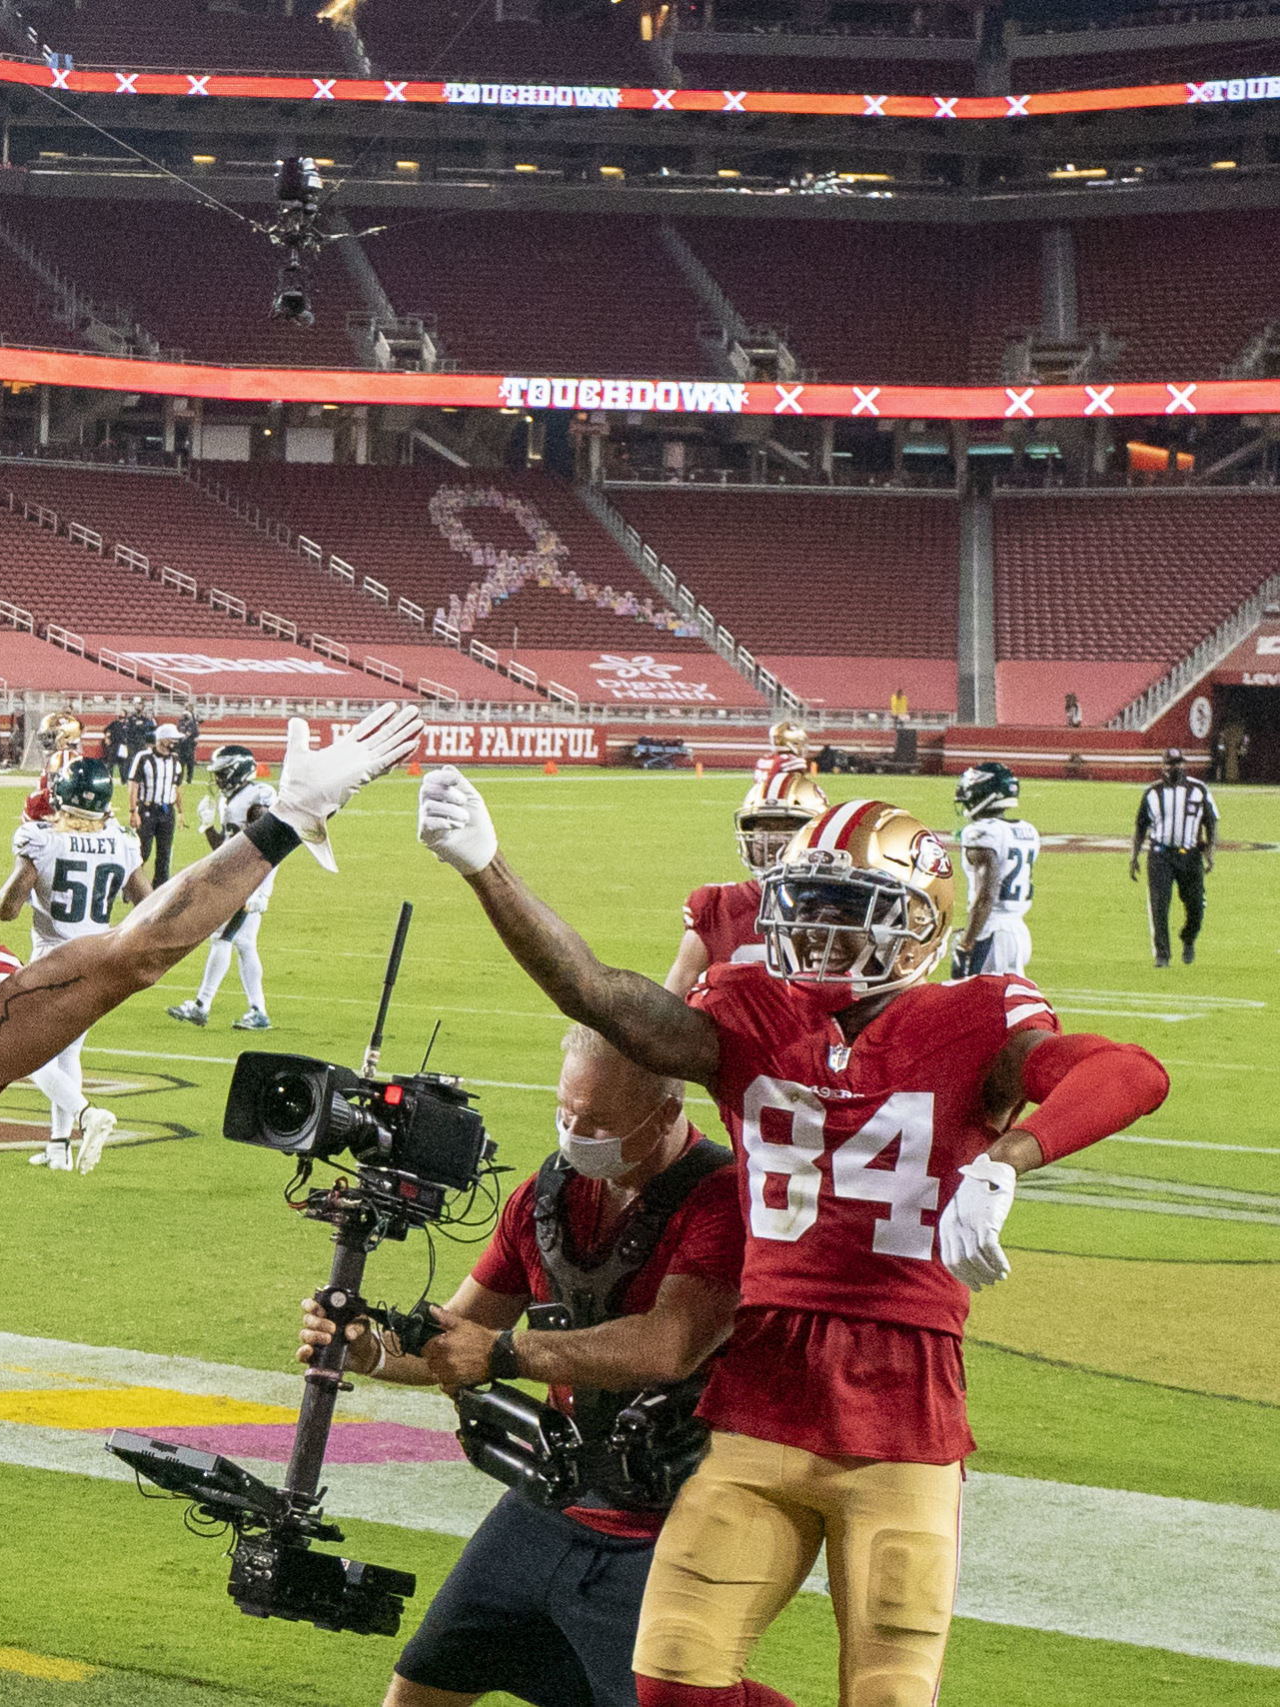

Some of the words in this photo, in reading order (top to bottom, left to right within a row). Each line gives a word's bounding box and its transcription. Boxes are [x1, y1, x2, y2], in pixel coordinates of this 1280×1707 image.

[505, 377, 745, 412] TOUCHDOWN
[424, 725, 475, 757] THE
[479, 726, 599, 759] FAITHFUL
[70, 836, 116, 855] RILEY
[50, 857, 126, 924] 50
[742, 1074, 939, 1261] 84
